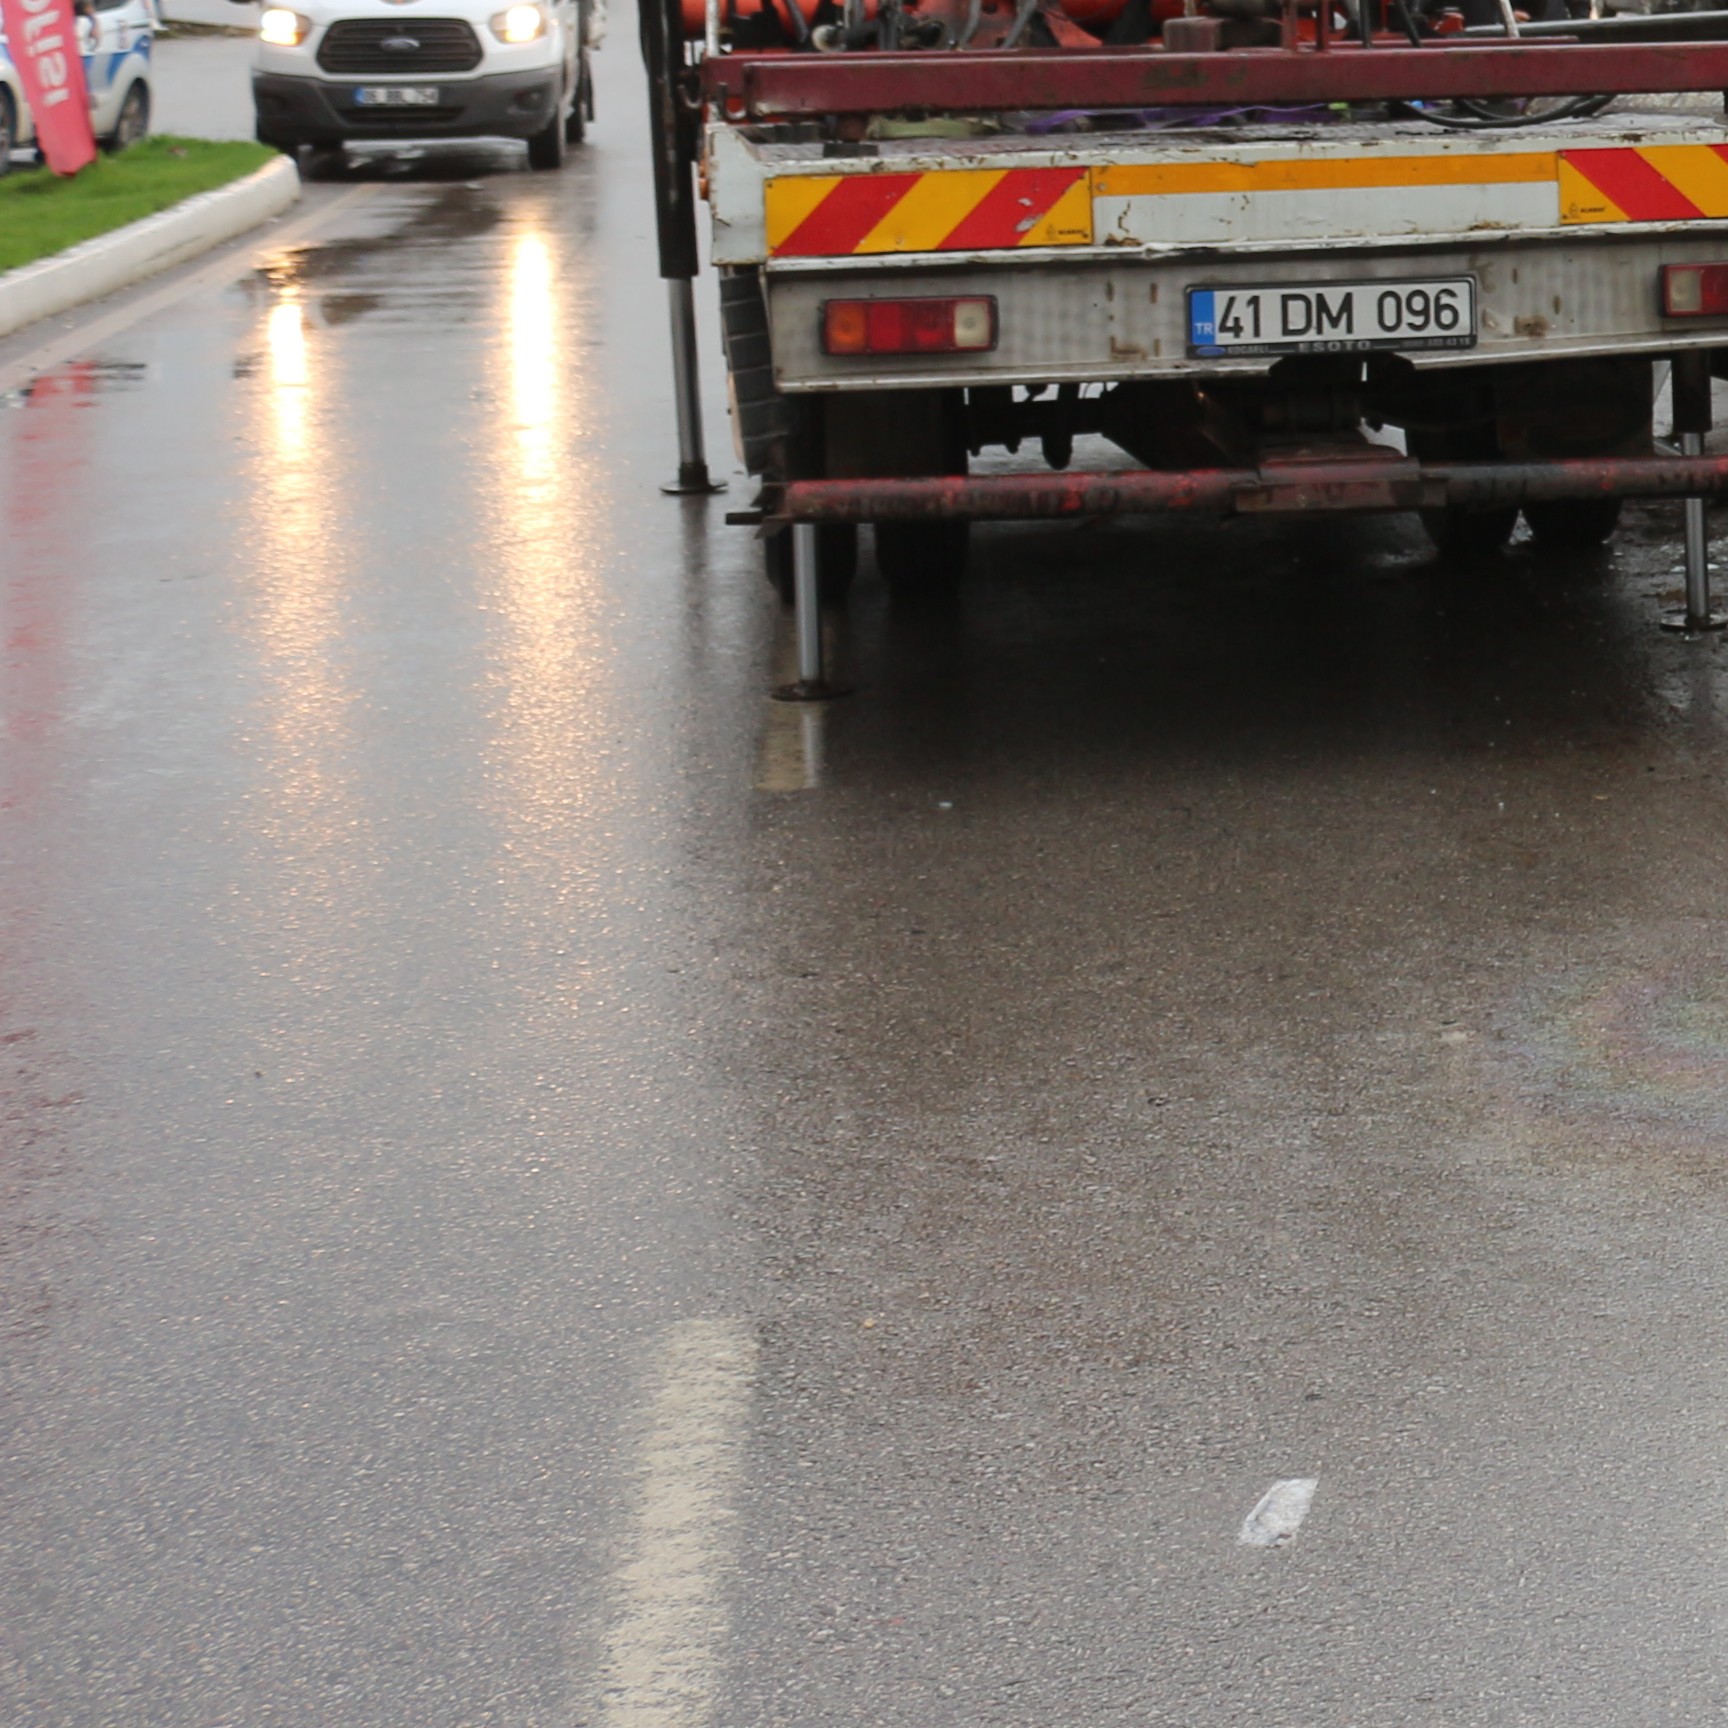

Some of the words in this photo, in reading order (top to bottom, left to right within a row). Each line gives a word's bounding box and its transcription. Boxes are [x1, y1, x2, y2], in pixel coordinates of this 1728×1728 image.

[1218, 295, 1261, 338] 41
[1281, 291, 1354, 337] DM
[1377, 288, 1460, 333] 096
[1195, 323, 1214, 335] TR
[1298, 340, 1371, 353] ESOTO
